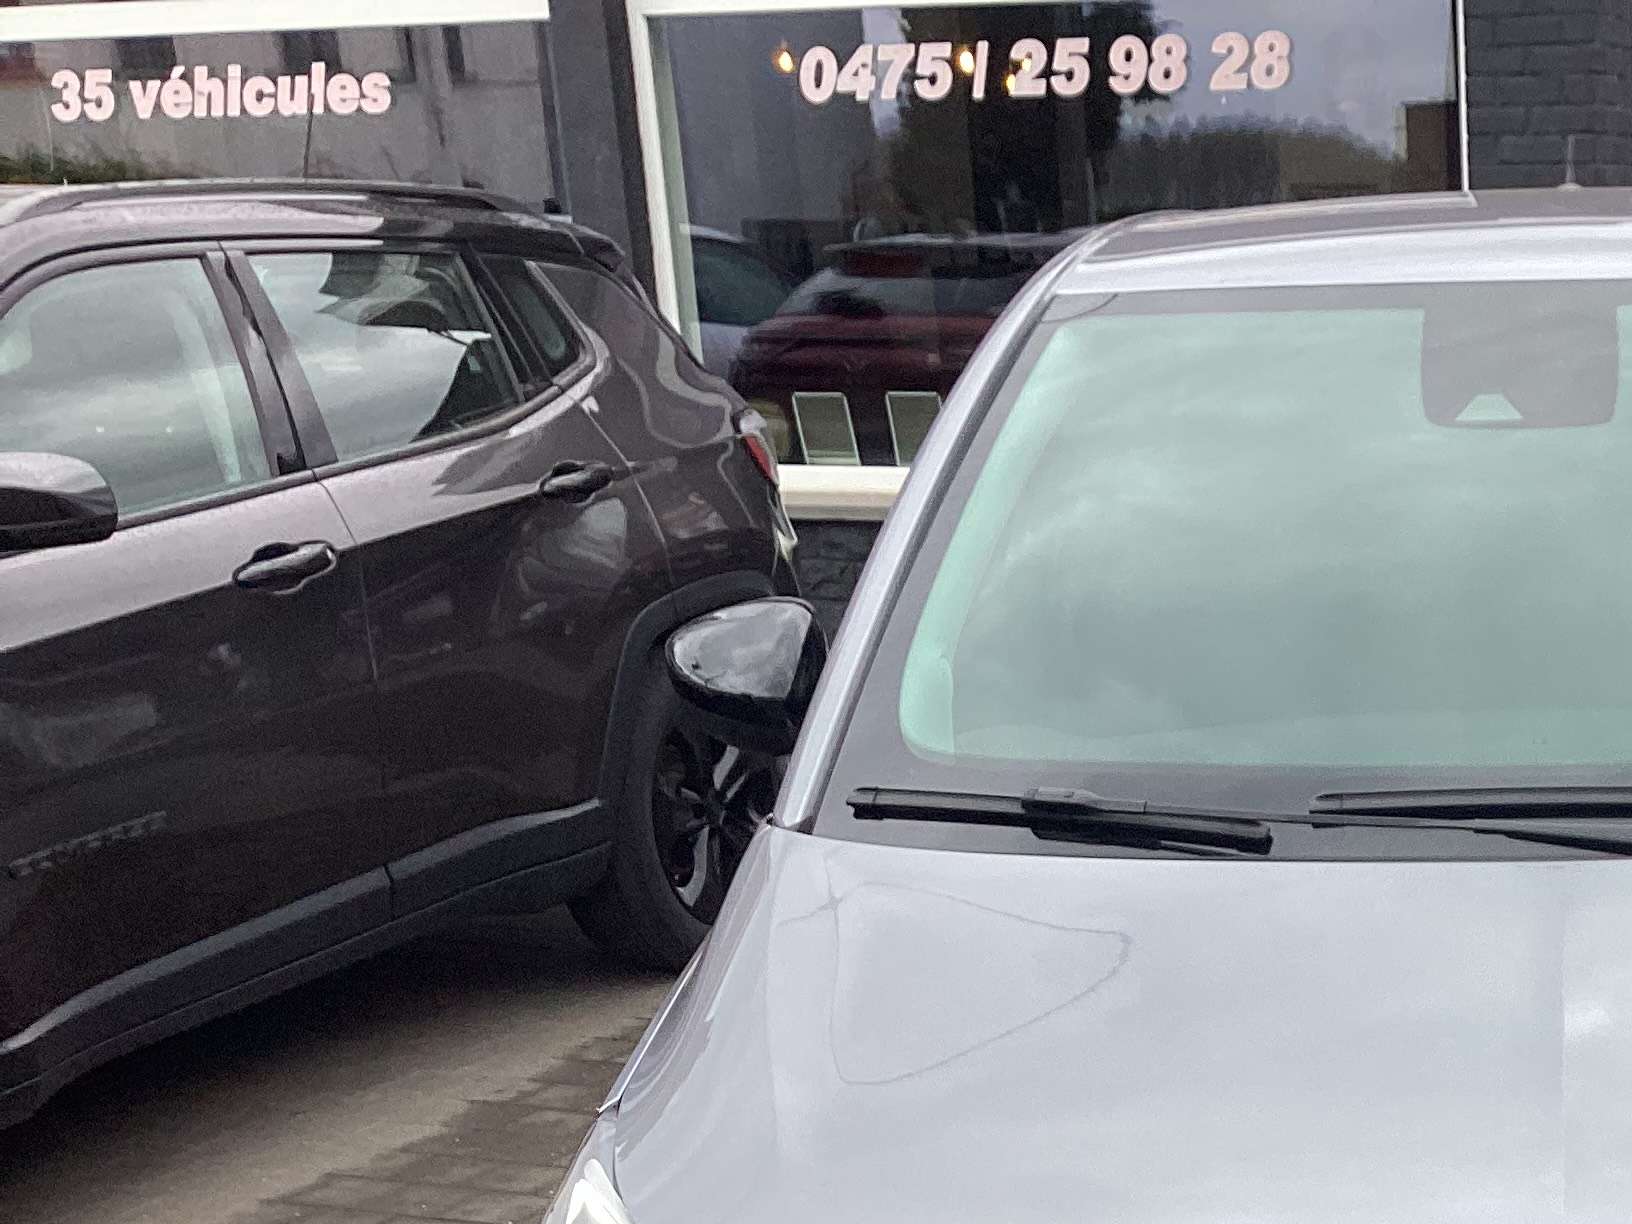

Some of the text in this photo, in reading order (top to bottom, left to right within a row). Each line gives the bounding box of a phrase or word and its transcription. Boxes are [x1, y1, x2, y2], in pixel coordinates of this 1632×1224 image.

[51, 61, 392, 122] 35 véhicules
[1008, 36, 1091, 98] 25
[1109, 33, 1188, 95] 98
[1208, 30, 1293, 91] 28
